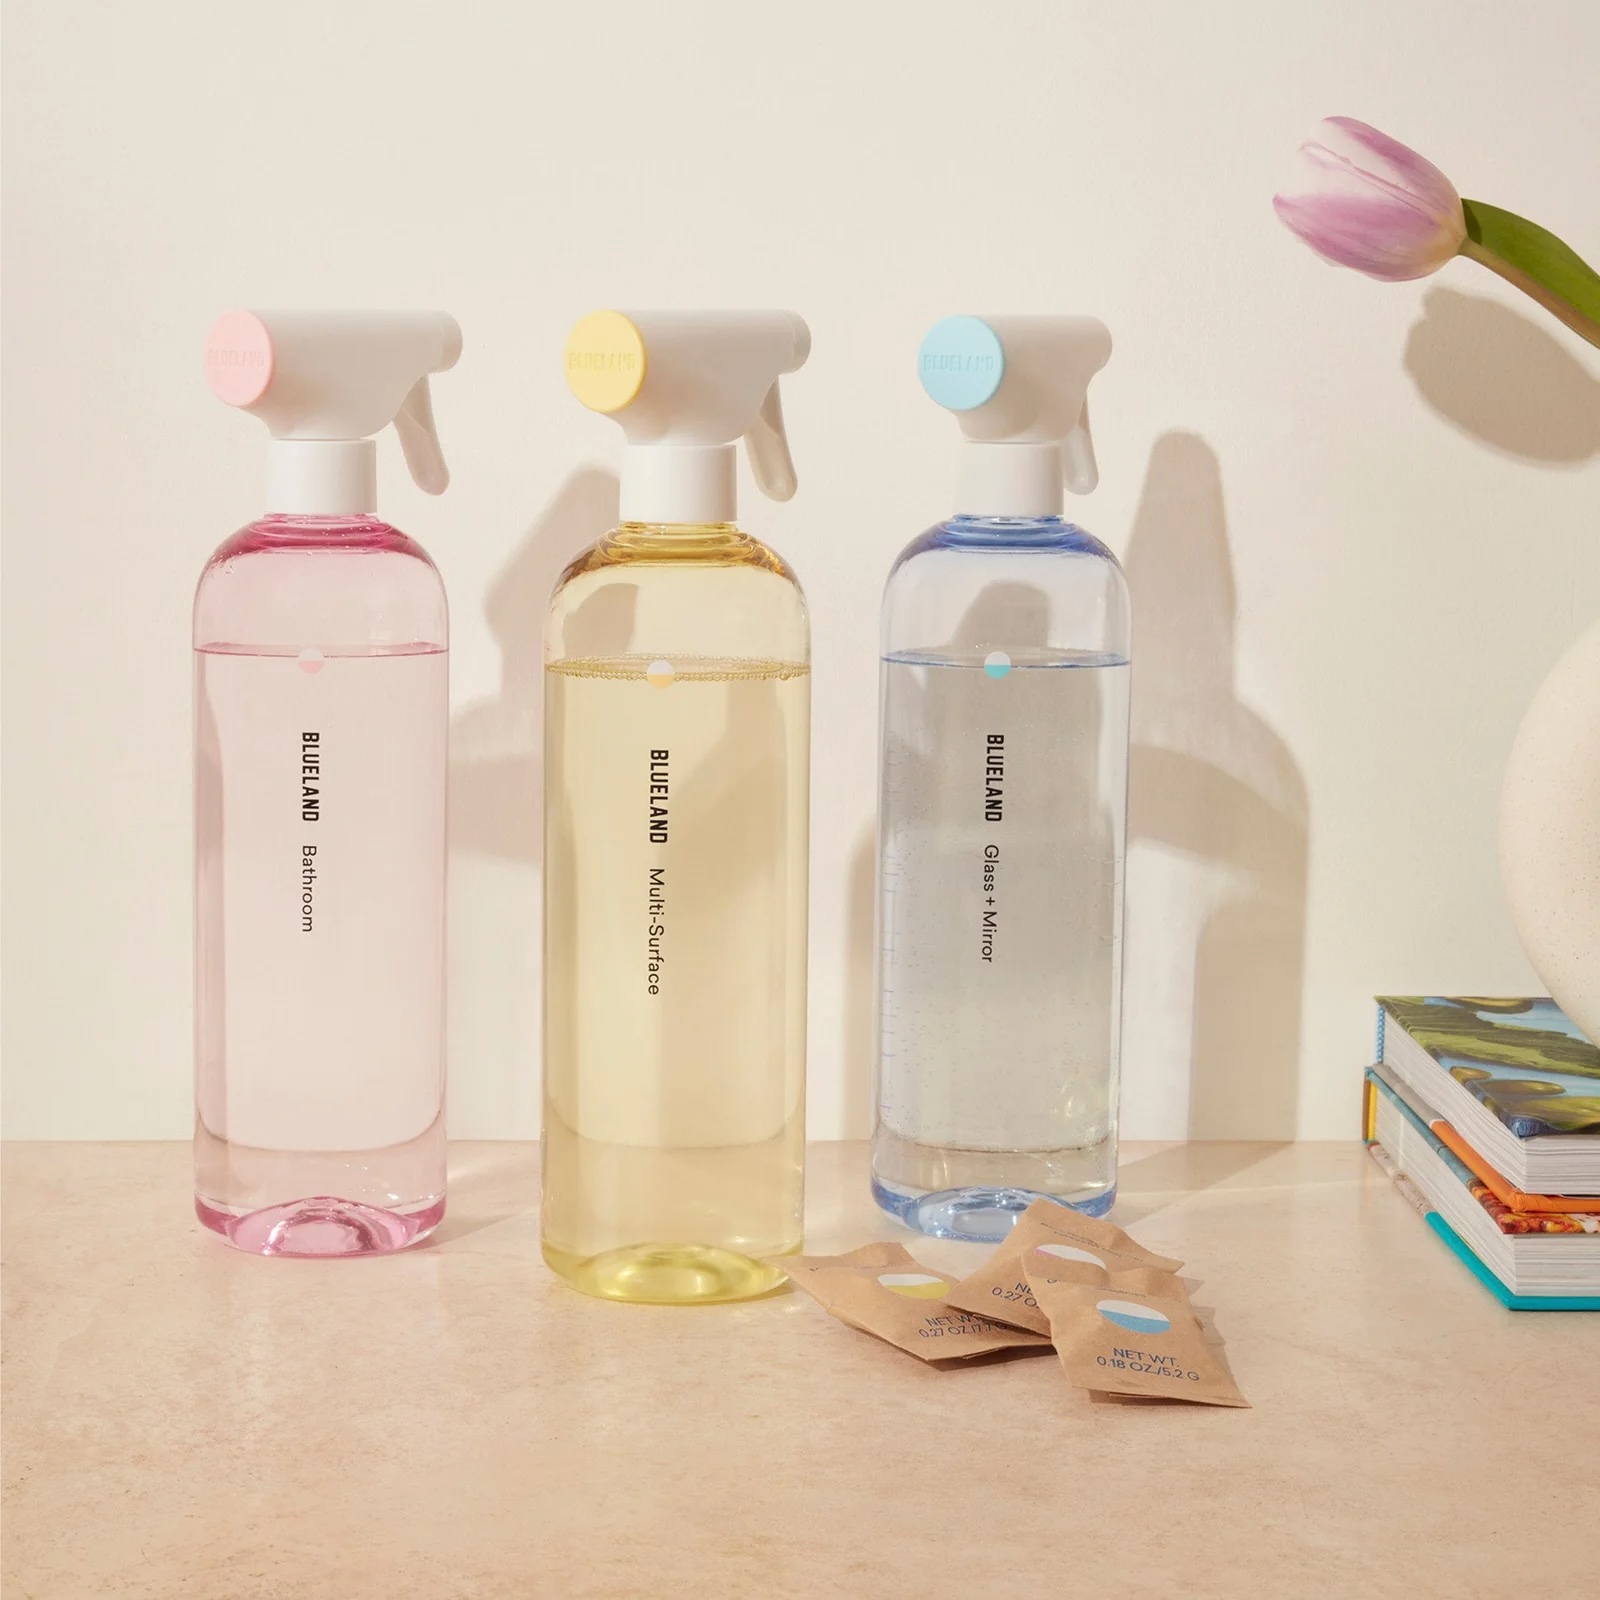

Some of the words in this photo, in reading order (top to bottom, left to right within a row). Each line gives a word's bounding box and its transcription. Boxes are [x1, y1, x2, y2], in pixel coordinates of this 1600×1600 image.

[568, 352, 636, 370] BLUELAND
[923, 354, 994, 371] BLUELAND
[302, 731, 320, 822] BLUELAND
[985, 734, 1004, 822] BLUELAND
[650, 749, 669, 844] BLUELAND
[984, 844, 999, 892] Glass
[301, 845, 318, 933] Bathroom
[984, 897, 995, 907] +
[647, 868, 665, 996] Multi-Surface
[981, 911, 998, 963] Mirror
[991, 1287, 1022, 1301] 0.27
[918, 1328, 944, 1338] 0.27
[925, 1316, 953, 1327] NET
[1096, 1355, 1126, 1369] 0.18
[1187, 1371, 1200, 1382] G
[1113, 1347, 1144, 1361] NET
[1148, 1353, 1180, 1368] WT.
